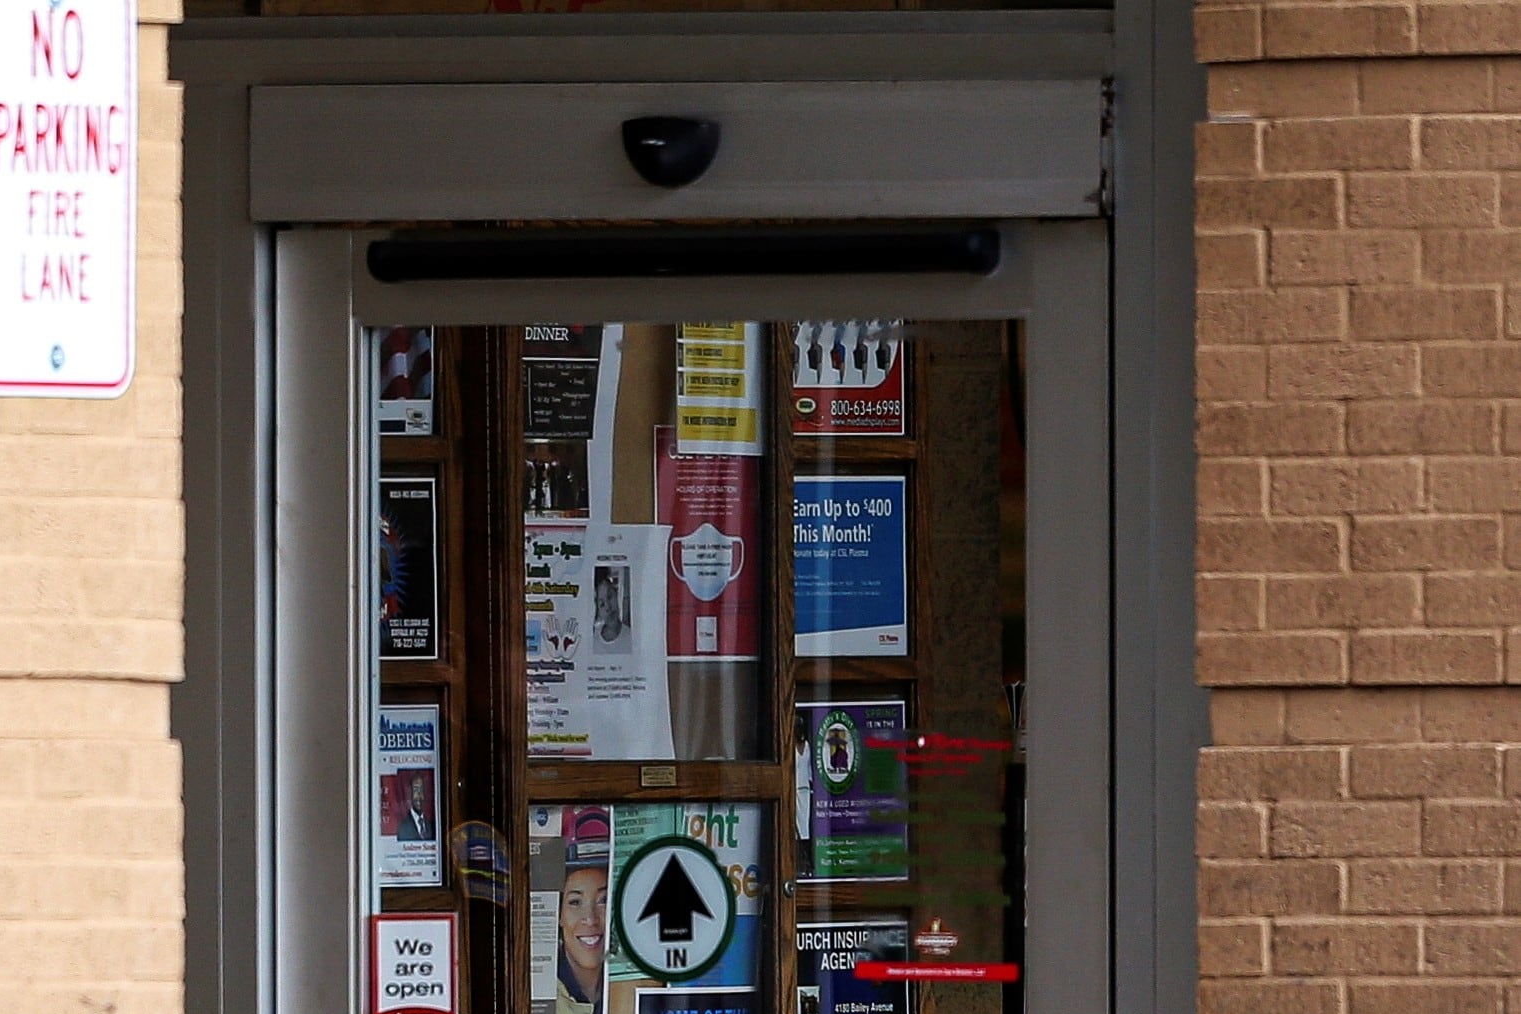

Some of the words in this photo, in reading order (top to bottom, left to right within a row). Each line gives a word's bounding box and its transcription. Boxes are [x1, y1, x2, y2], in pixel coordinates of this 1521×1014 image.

[31, 10, 84, 80] NO
[27, 190, 86, 238] FIRE
[21, 252, 91, 302] LANE
[525, 327, 569, 341] DINNER
[831, 400, 901, 415] 800-634-6998
[794, 500, 820, 517] Earn
[824, 499, 842, 521] Up
[845, 501, 860, 517] to
[863, 498, 892, 517] $400
[794, 524, 818, 543] This
[813, 549, 829, 560] today
[849, 549, 869, 557] Plasma
[874, 720, 881, 729] IN
[882, 720, 894, 729] THE
[721, 864, 759, 897] se
[394, 939, 434, 956] We
[666, 949, 687, 968] IN
[394, 961, 434, 977] are
[385, 981, 444, 999] open
[850, 1003, 869, 1014] Bailey
[870, 1002, 894, 1013] Avenue
